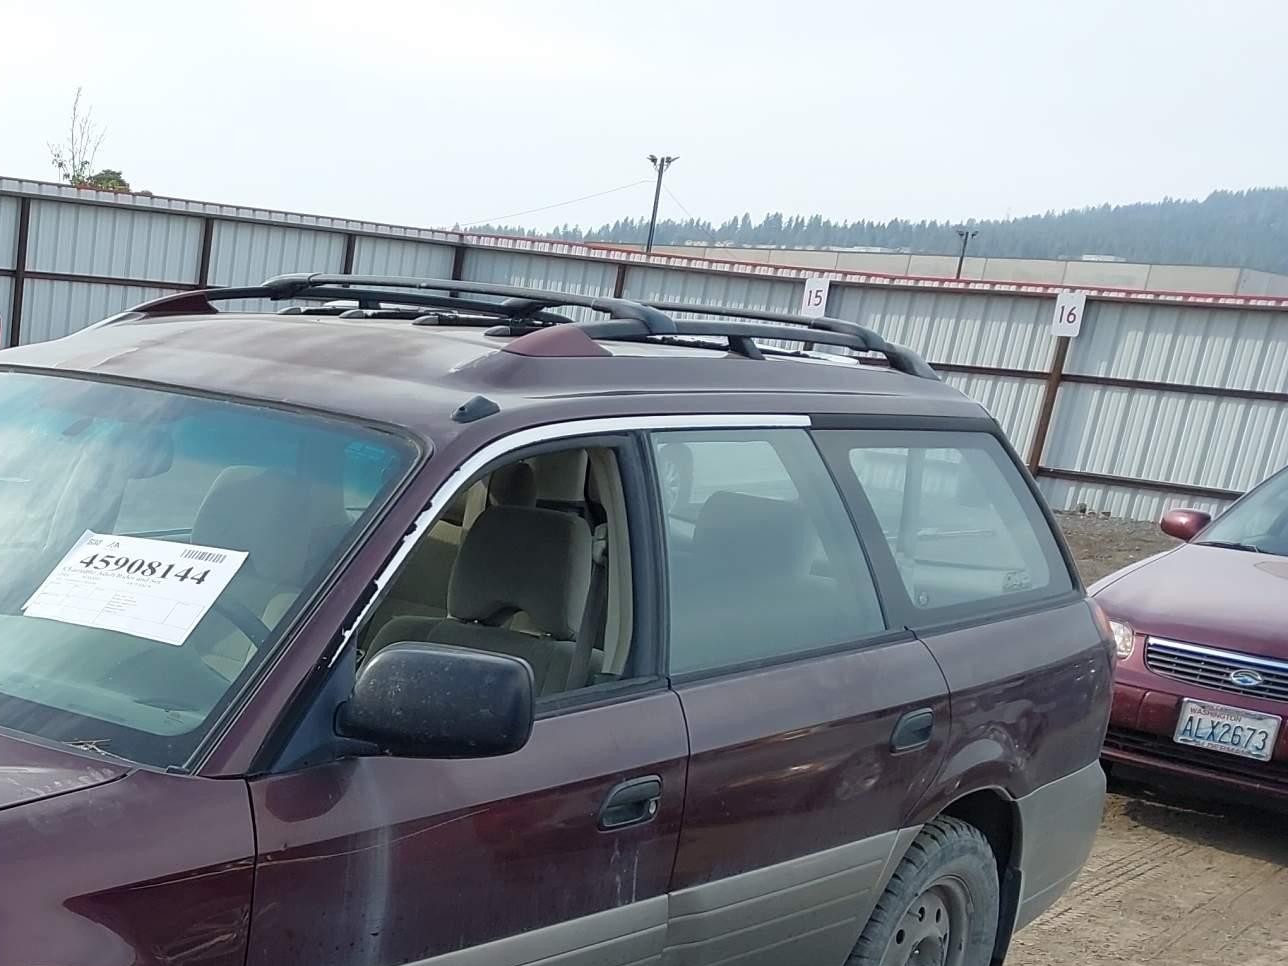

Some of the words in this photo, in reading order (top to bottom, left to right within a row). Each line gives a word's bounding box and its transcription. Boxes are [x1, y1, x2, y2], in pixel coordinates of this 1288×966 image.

[806, 288, 823, 307] 15
[1058, 304, 1077, 325] 16
[79, 553, 212, 585] 45908144
[1182, 715, 1269, 751] ALX2673
